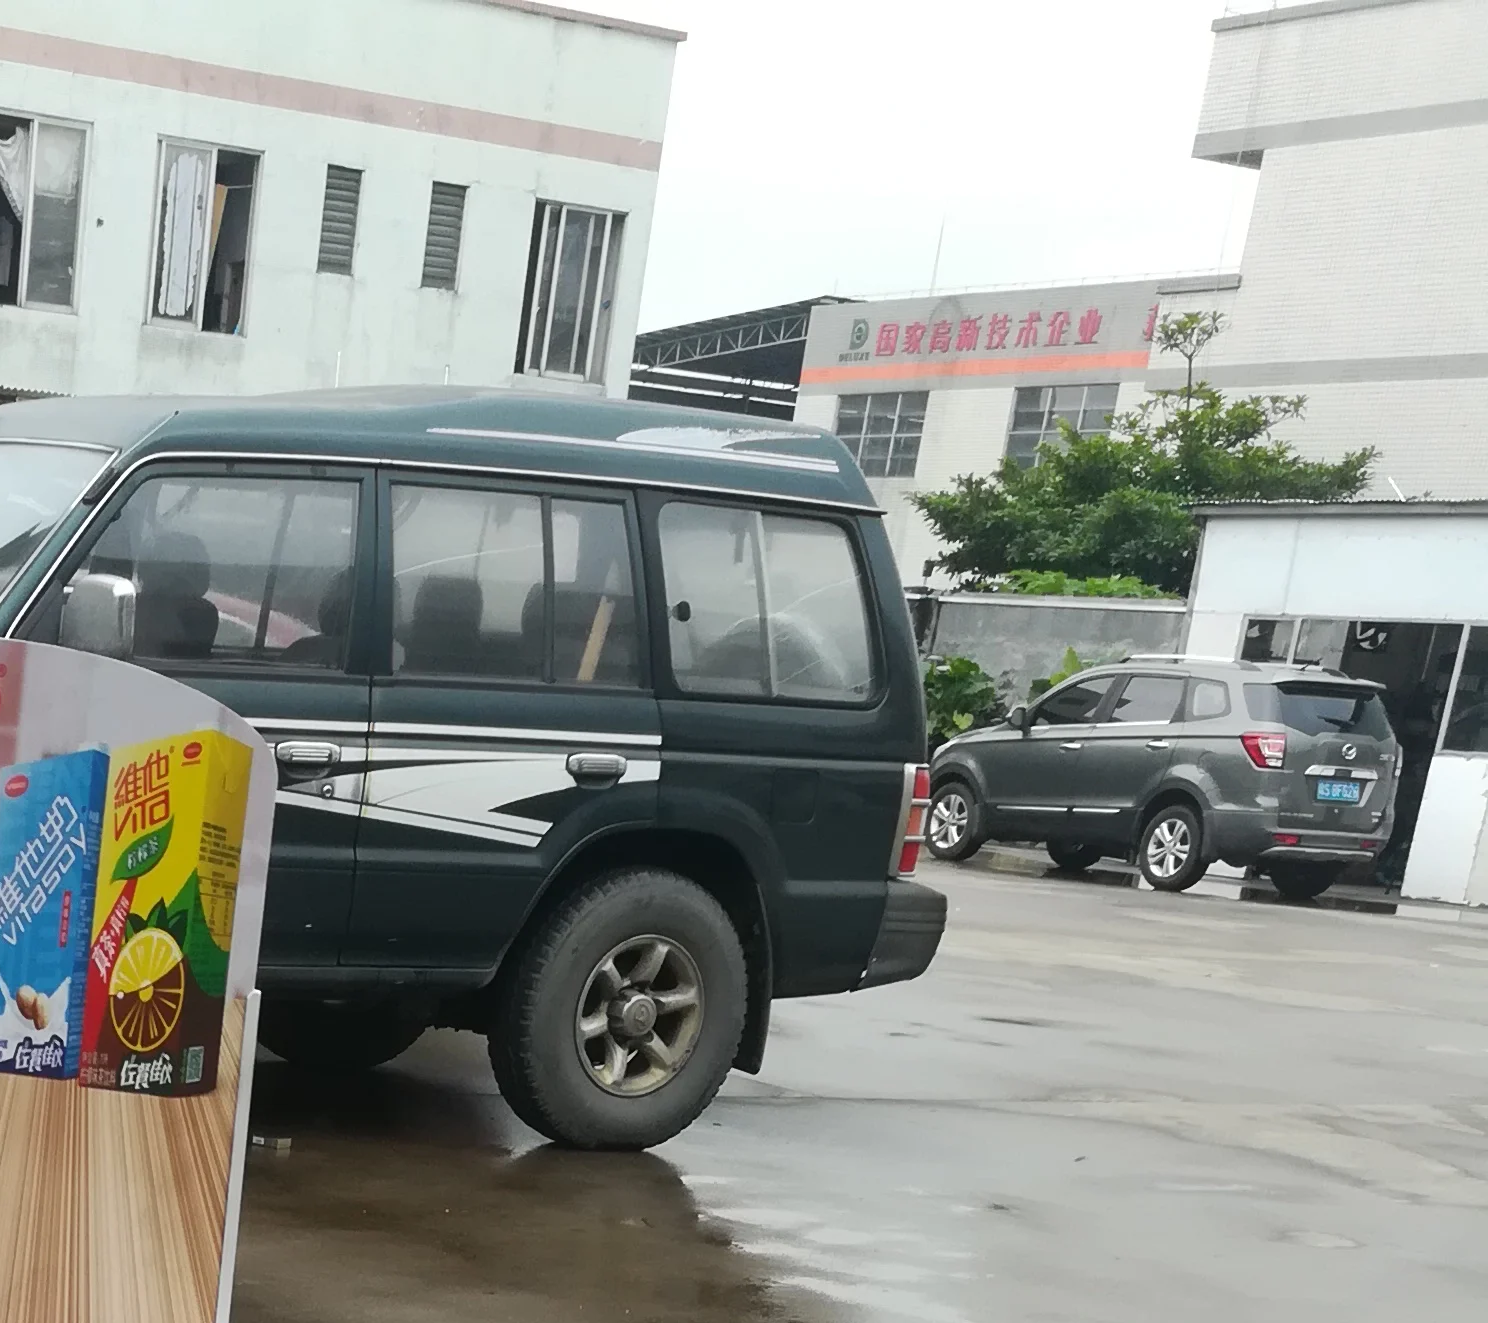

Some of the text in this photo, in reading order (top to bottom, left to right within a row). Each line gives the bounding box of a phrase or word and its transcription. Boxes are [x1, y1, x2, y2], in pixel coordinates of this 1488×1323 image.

[875, 307, 1103, 357] 国家高新技术企业
